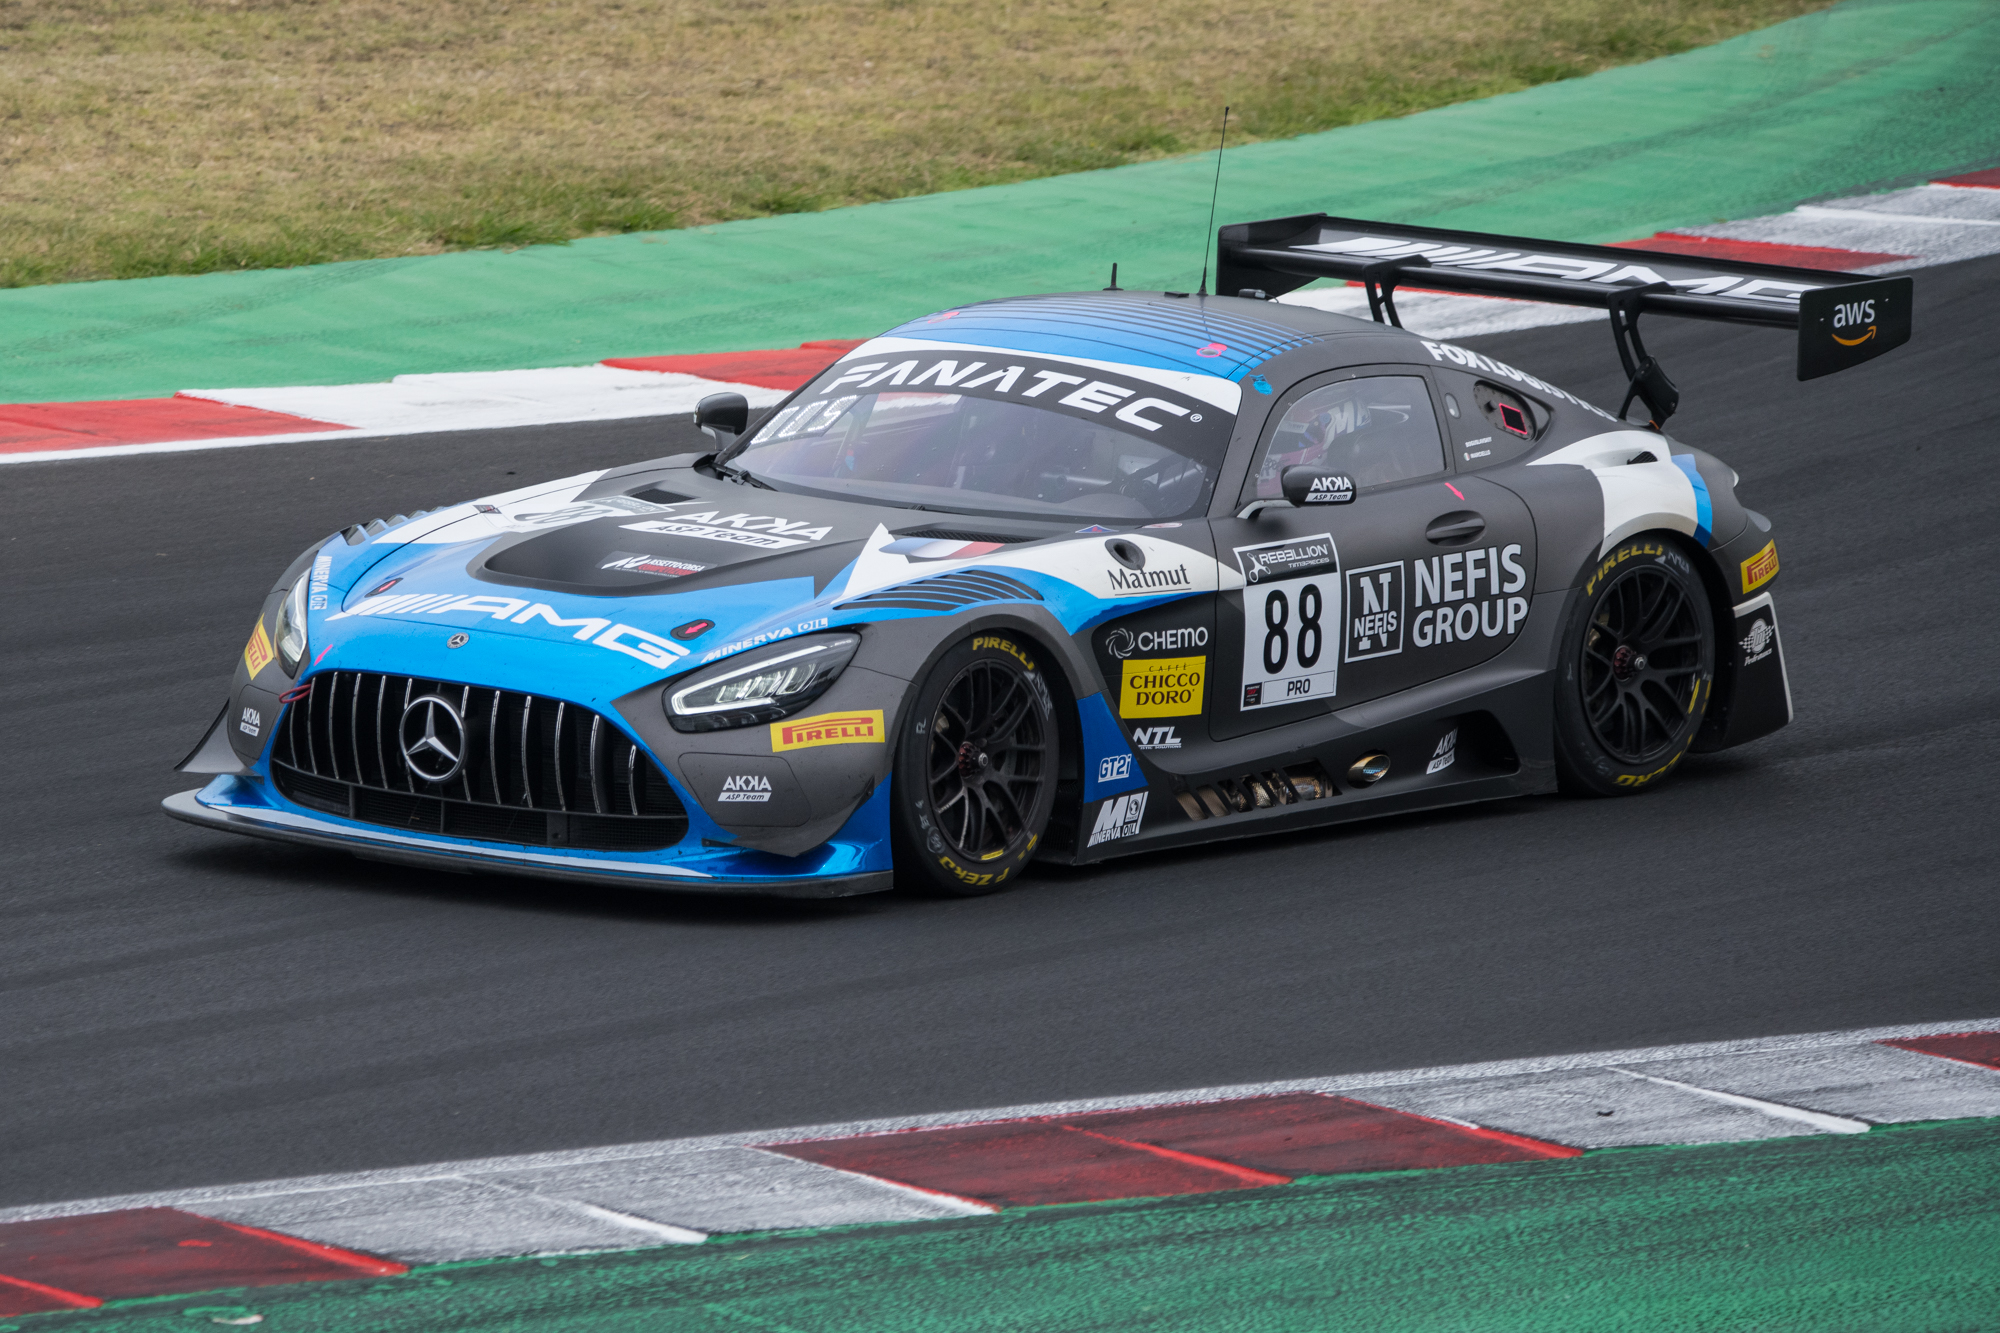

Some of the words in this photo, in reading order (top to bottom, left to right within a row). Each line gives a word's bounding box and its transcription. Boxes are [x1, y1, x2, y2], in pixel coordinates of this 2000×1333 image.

[1833, 298, 1876, 329] aws
[1420, 340, 1490, 372] FOX
[819, 359, 1191, 431] FANATEC
[1310, 477, 1352, 491] AKKA
[1312, 493, 1327, 501] ASP
[1329, 493, 1349, 501] Team
[650, 525, 701, 534] ASP
[704, 527, 780, 546] Team
[664, 511, 833, 540] AKKA
[1259, 544, 1328, 565] REBELLION
[1747, 547, 1778, 585] PIRELLI
[311, 556, 332, 594] MINERVA
[1107, 563, 1191, 591] Matmut
[1414, 544, 1527, 608] NEFIS
[1586, 544, 1663, 596] PIRELLI
[428, 595, 690, 669] AMG
[1263, 583, 1323, 675] 88
[1354, 610, 1397, 638] NEFIS
[1412, 596, 1528, 648] GROUP
[700, 627, 793, 663] MINERVA
[799, 619, 828, 632] OIL
[1138, 626, 1208, 651] CHEMO
[972, 636, 1035, 671] PIRELLI
[1129, 672, 1200, 689] CHICCO
[1287, 678, 1311, 696] PRO
[242, 707, 260, 727] AKKA
[782, 717, 874, 745] PIRELLI
[1133, 726, 1182, 745] NTL
[722, 775, 772, 791] AKKA
[1087, 827, 1120, 848] MINERVA
